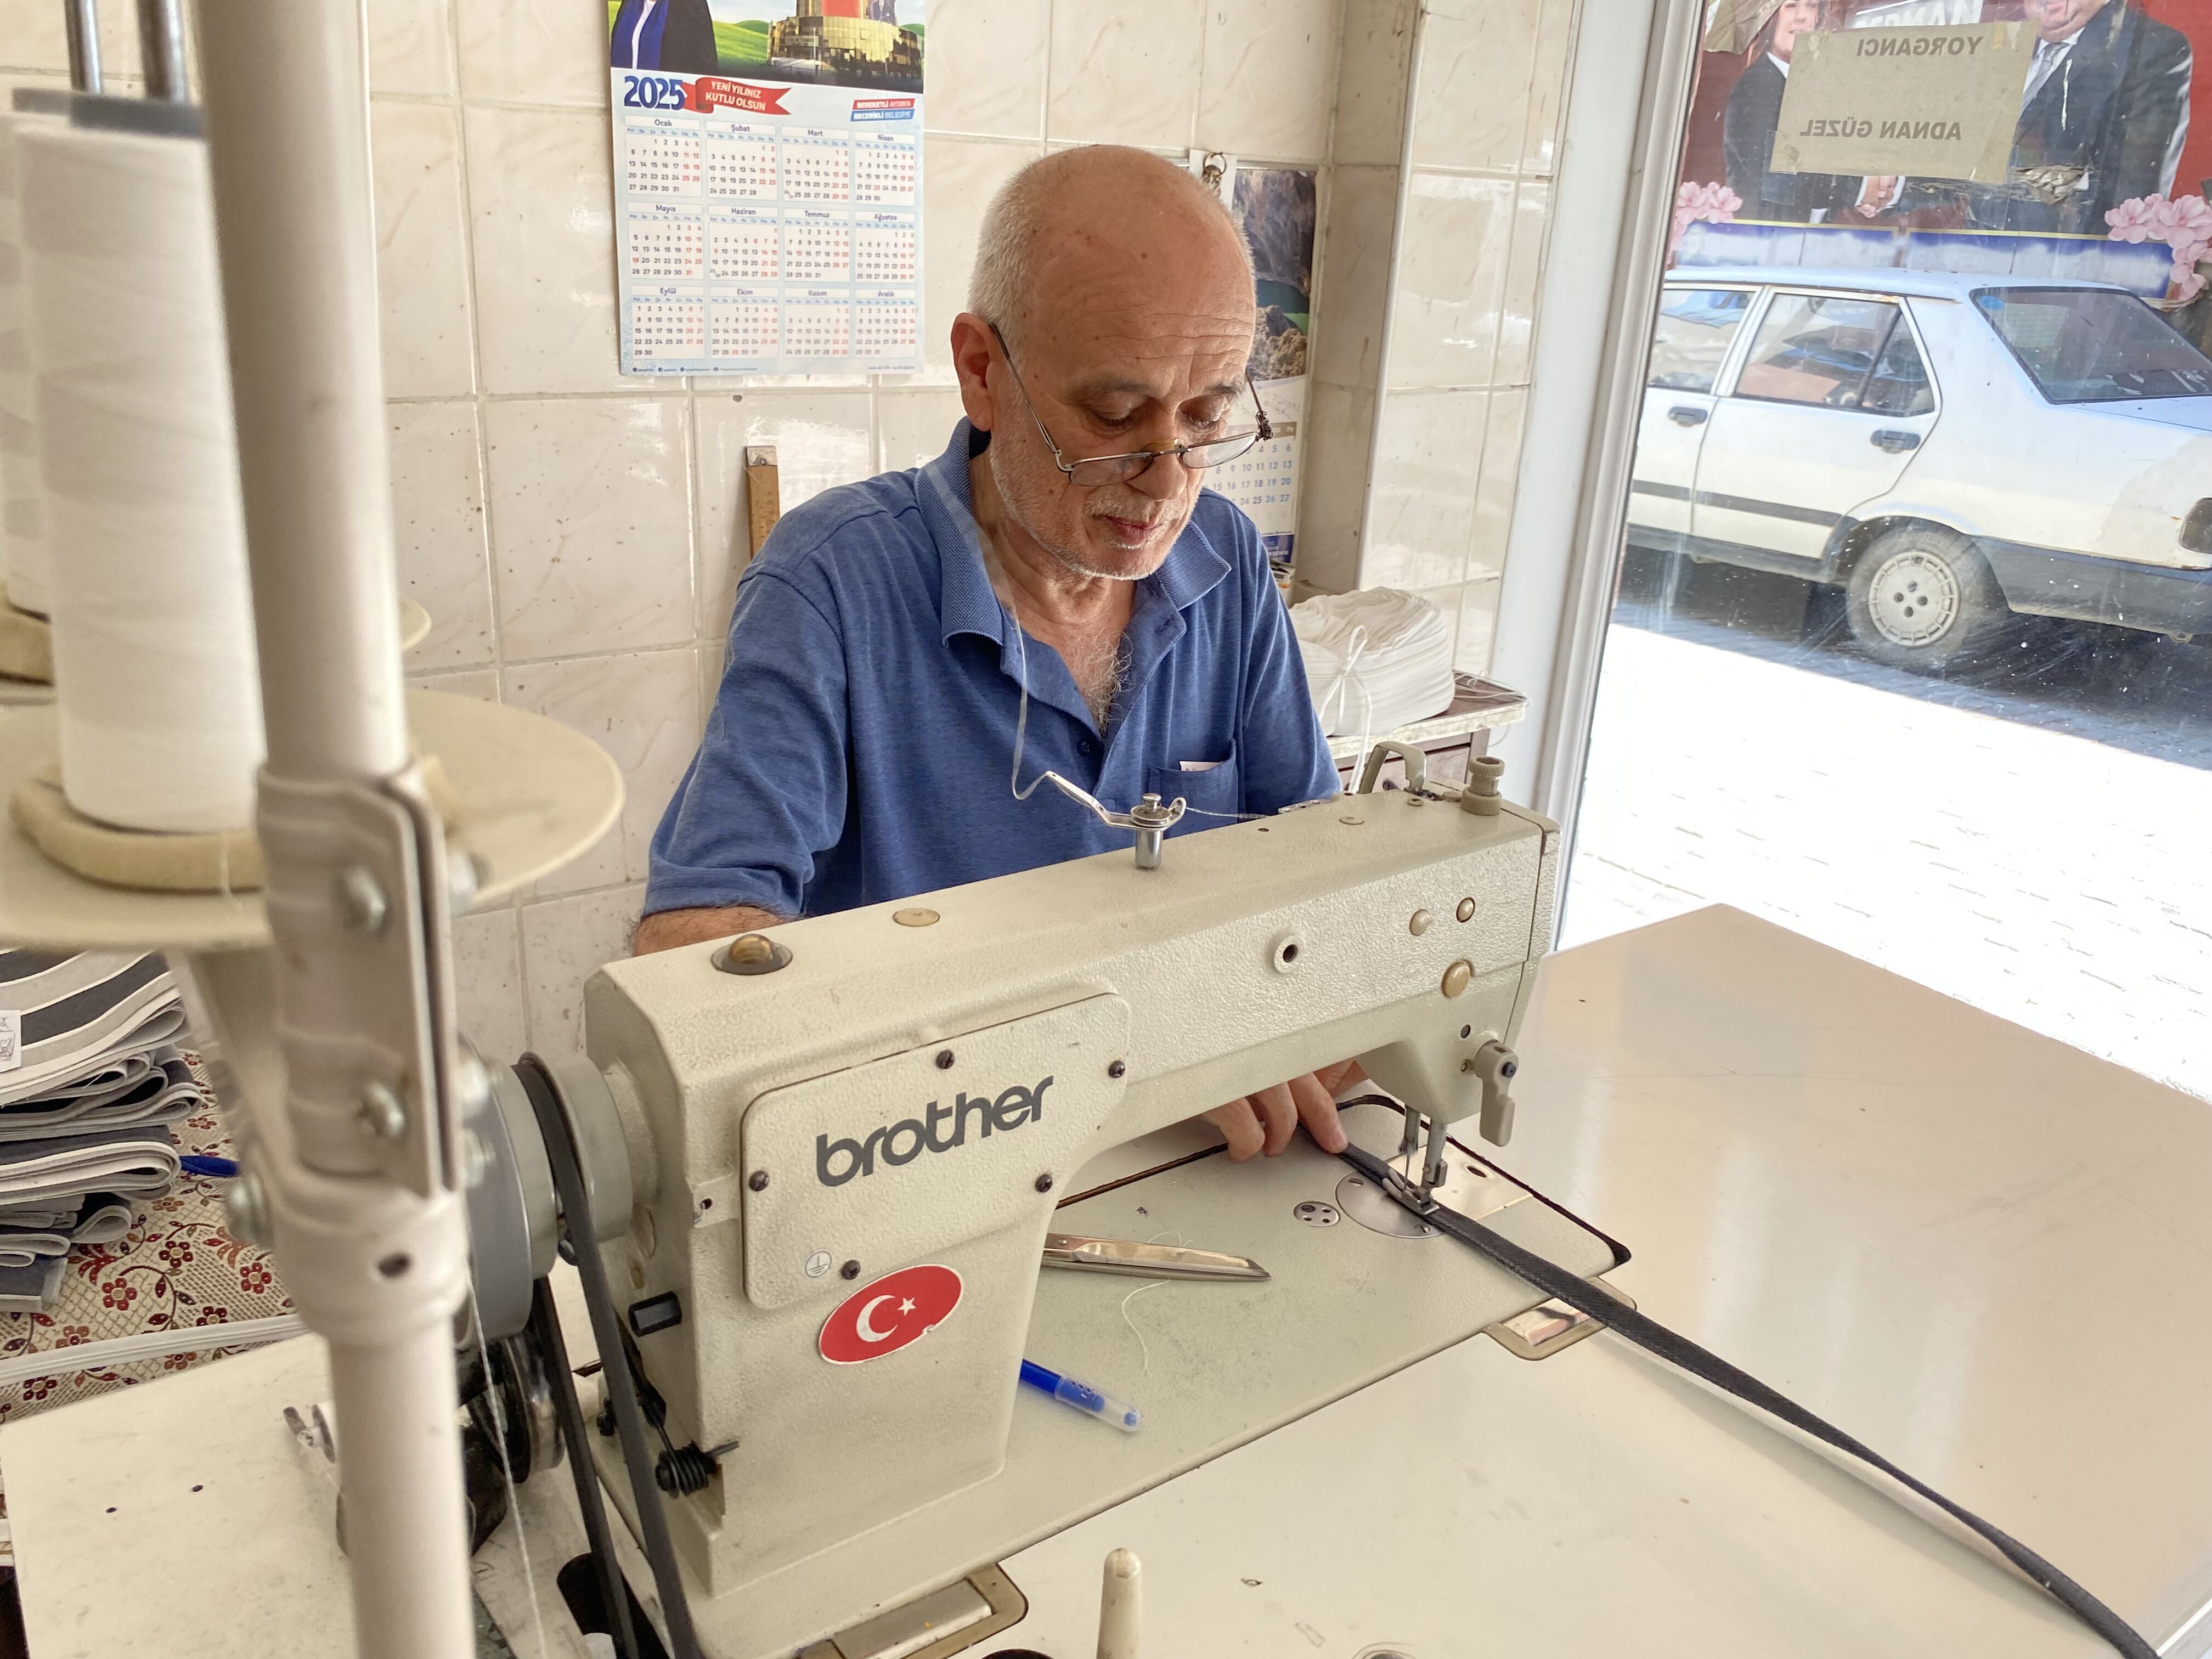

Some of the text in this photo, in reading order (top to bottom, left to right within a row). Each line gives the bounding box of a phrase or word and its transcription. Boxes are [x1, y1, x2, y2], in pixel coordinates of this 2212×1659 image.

[624, 76, 685, 110] 2025
[711, 80, 762, 99] YENİ YILINIZ
[706, 92, 766, 111] KUTLU OLSUN
[656, 205, 675, 213] Mayıs
[660, 287, 676, 296] Eylül
[1216, 466, 1221, 474] 8
[1230, 465, 1235, 473] 9
[1243, 464, 1252, 472] 10
[1256, 462, 1265, 471] 11
[1213, 483, 1222, 491] 15
[1228, 482, 1236, 490] 16
[1242, 481, 1251, 489] 17
[1240, 497, 1249, 506] 24
[1253, 496, 1262, 504] 25
[816, 1075, 1053, 1187] brother
